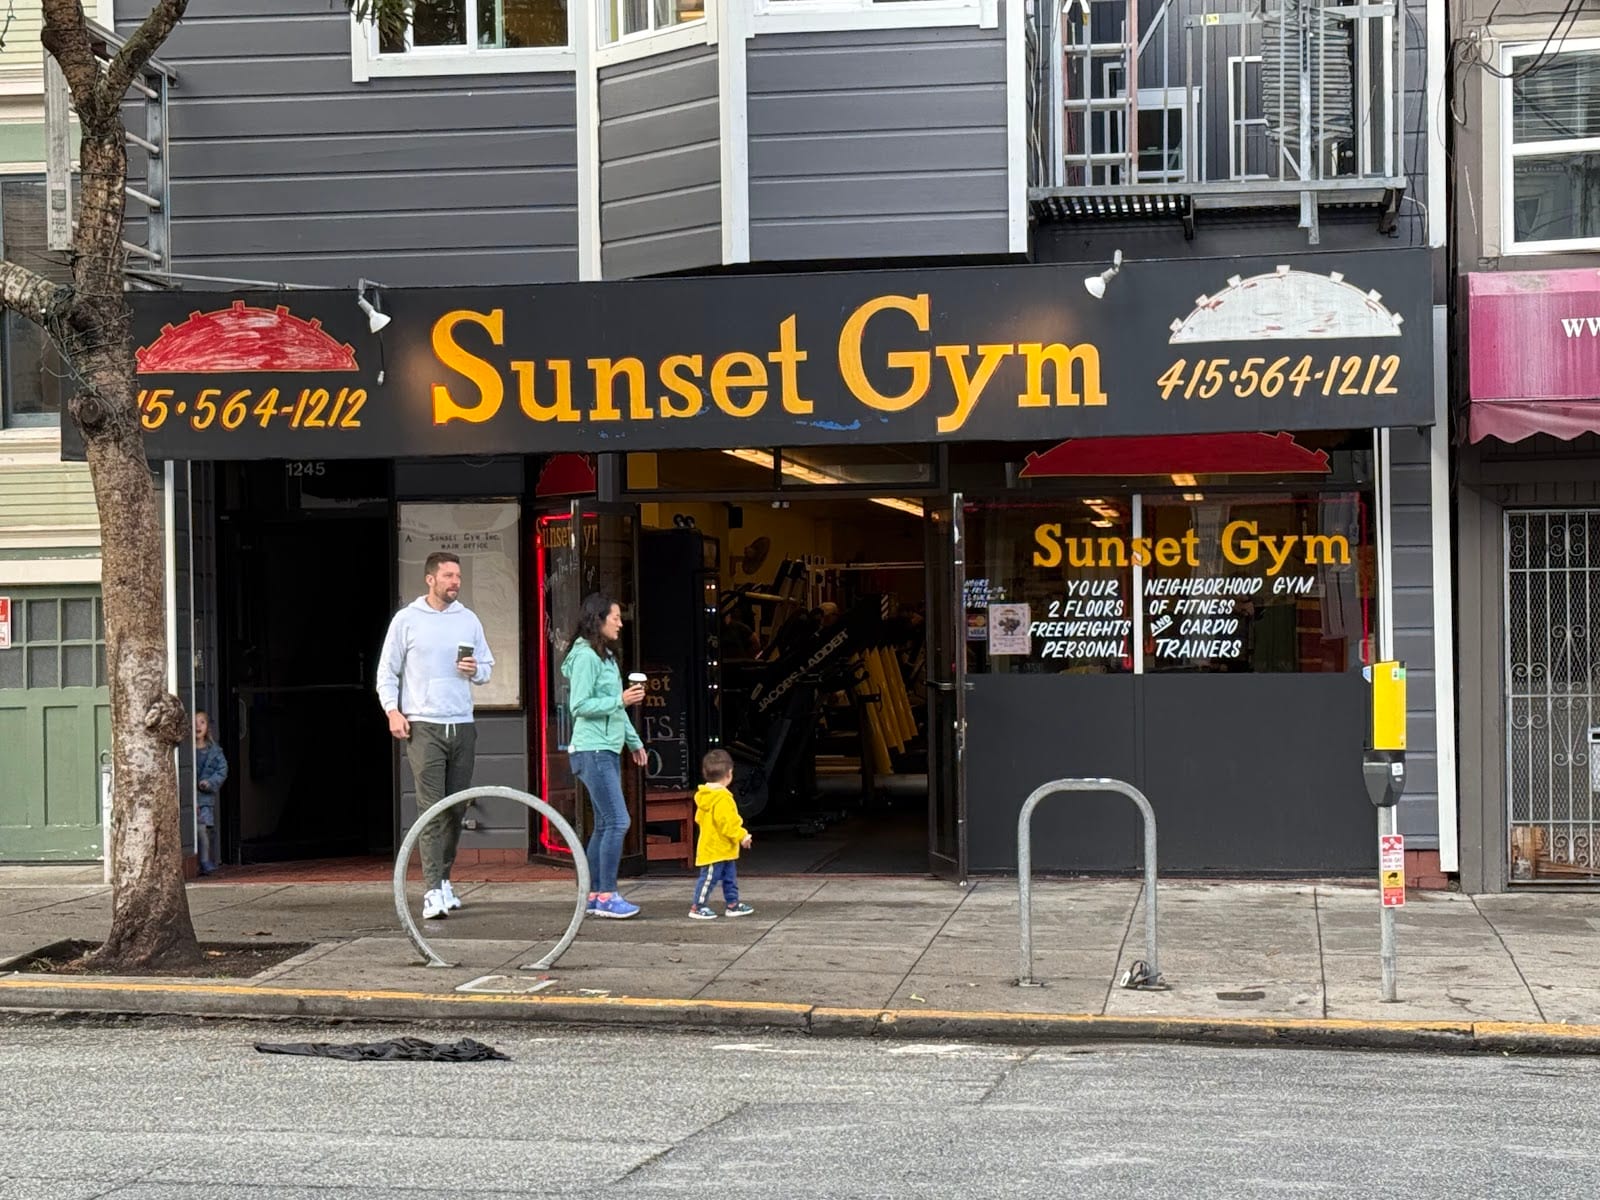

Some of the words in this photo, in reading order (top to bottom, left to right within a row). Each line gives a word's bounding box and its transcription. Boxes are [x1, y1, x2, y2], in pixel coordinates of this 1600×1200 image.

[431, 308, 814, 426] Sunset
[838, 293, 1108, 433] Gym
[285, 462, 326, 476] 1245
[463, 542, 489, 550] OFFICE
[1032, 522, 1202, 568] Sunset
[1221, 520, 1351, 576] Gym
[1067, 579, 1119, 597] YOUR
[1144, 577, 1263, 597] NEIGHBORHOOD
[1272, 576, 1315, 595] GYM
[1048, 600, 1060, 618] 2
[1063, 599, 1124, 618] FLOORS
[1149, 599, 1170, 616] OF
[1173, 599, 1236, 616] FITNESS
[1027, 620, 1132, 638] FREEWEIGHTS
[1149, 614, 1173, 636] AND
[1179, 618, 1239, 636] CARDIO
[1041, 639, 1129, 659] PERSONAL
[1155, 638, 1243, 659] TRAINERS
